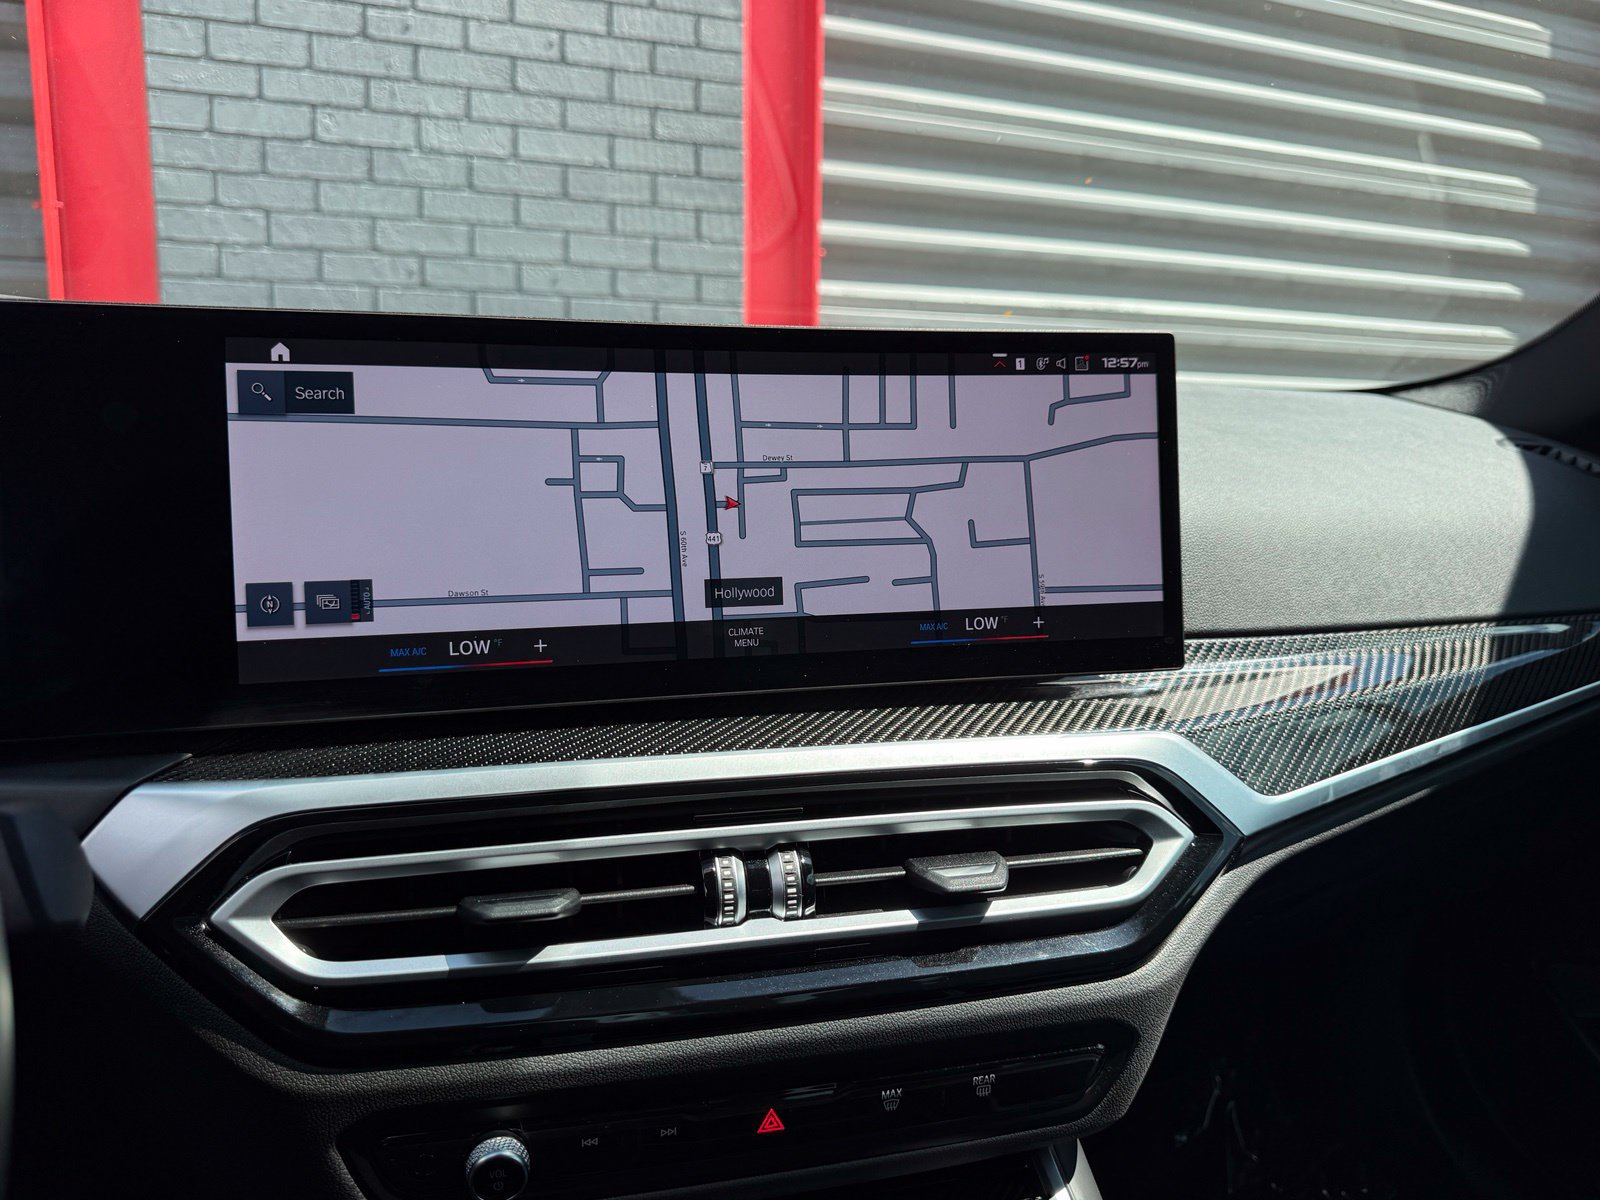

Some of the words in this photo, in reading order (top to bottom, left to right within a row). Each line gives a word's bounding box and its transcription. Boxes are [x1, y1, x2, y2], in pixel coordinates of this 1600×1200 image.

[295, 386, 345, 400] Search
[707, 535, 720, 543] 441
[714, 586, 775, 600] Hollywood
[363, 592, 371, 609] AUTO
[919, 623, 935, 631] MAX
[936, 622, 948, 630] A/C
[965, 617, 999, 631] LOW
[728, 627, 764, 637] CLIMATE
[449, 640, 491, 656] LOW
[734, 639, 759, 647] MENU
[390, 648, 410, 657] MAX
[412, 647, 427, 656] A/C
[973, 1074, 996, 1086] REAR
[881, 1088, 902, 1100] MAX
